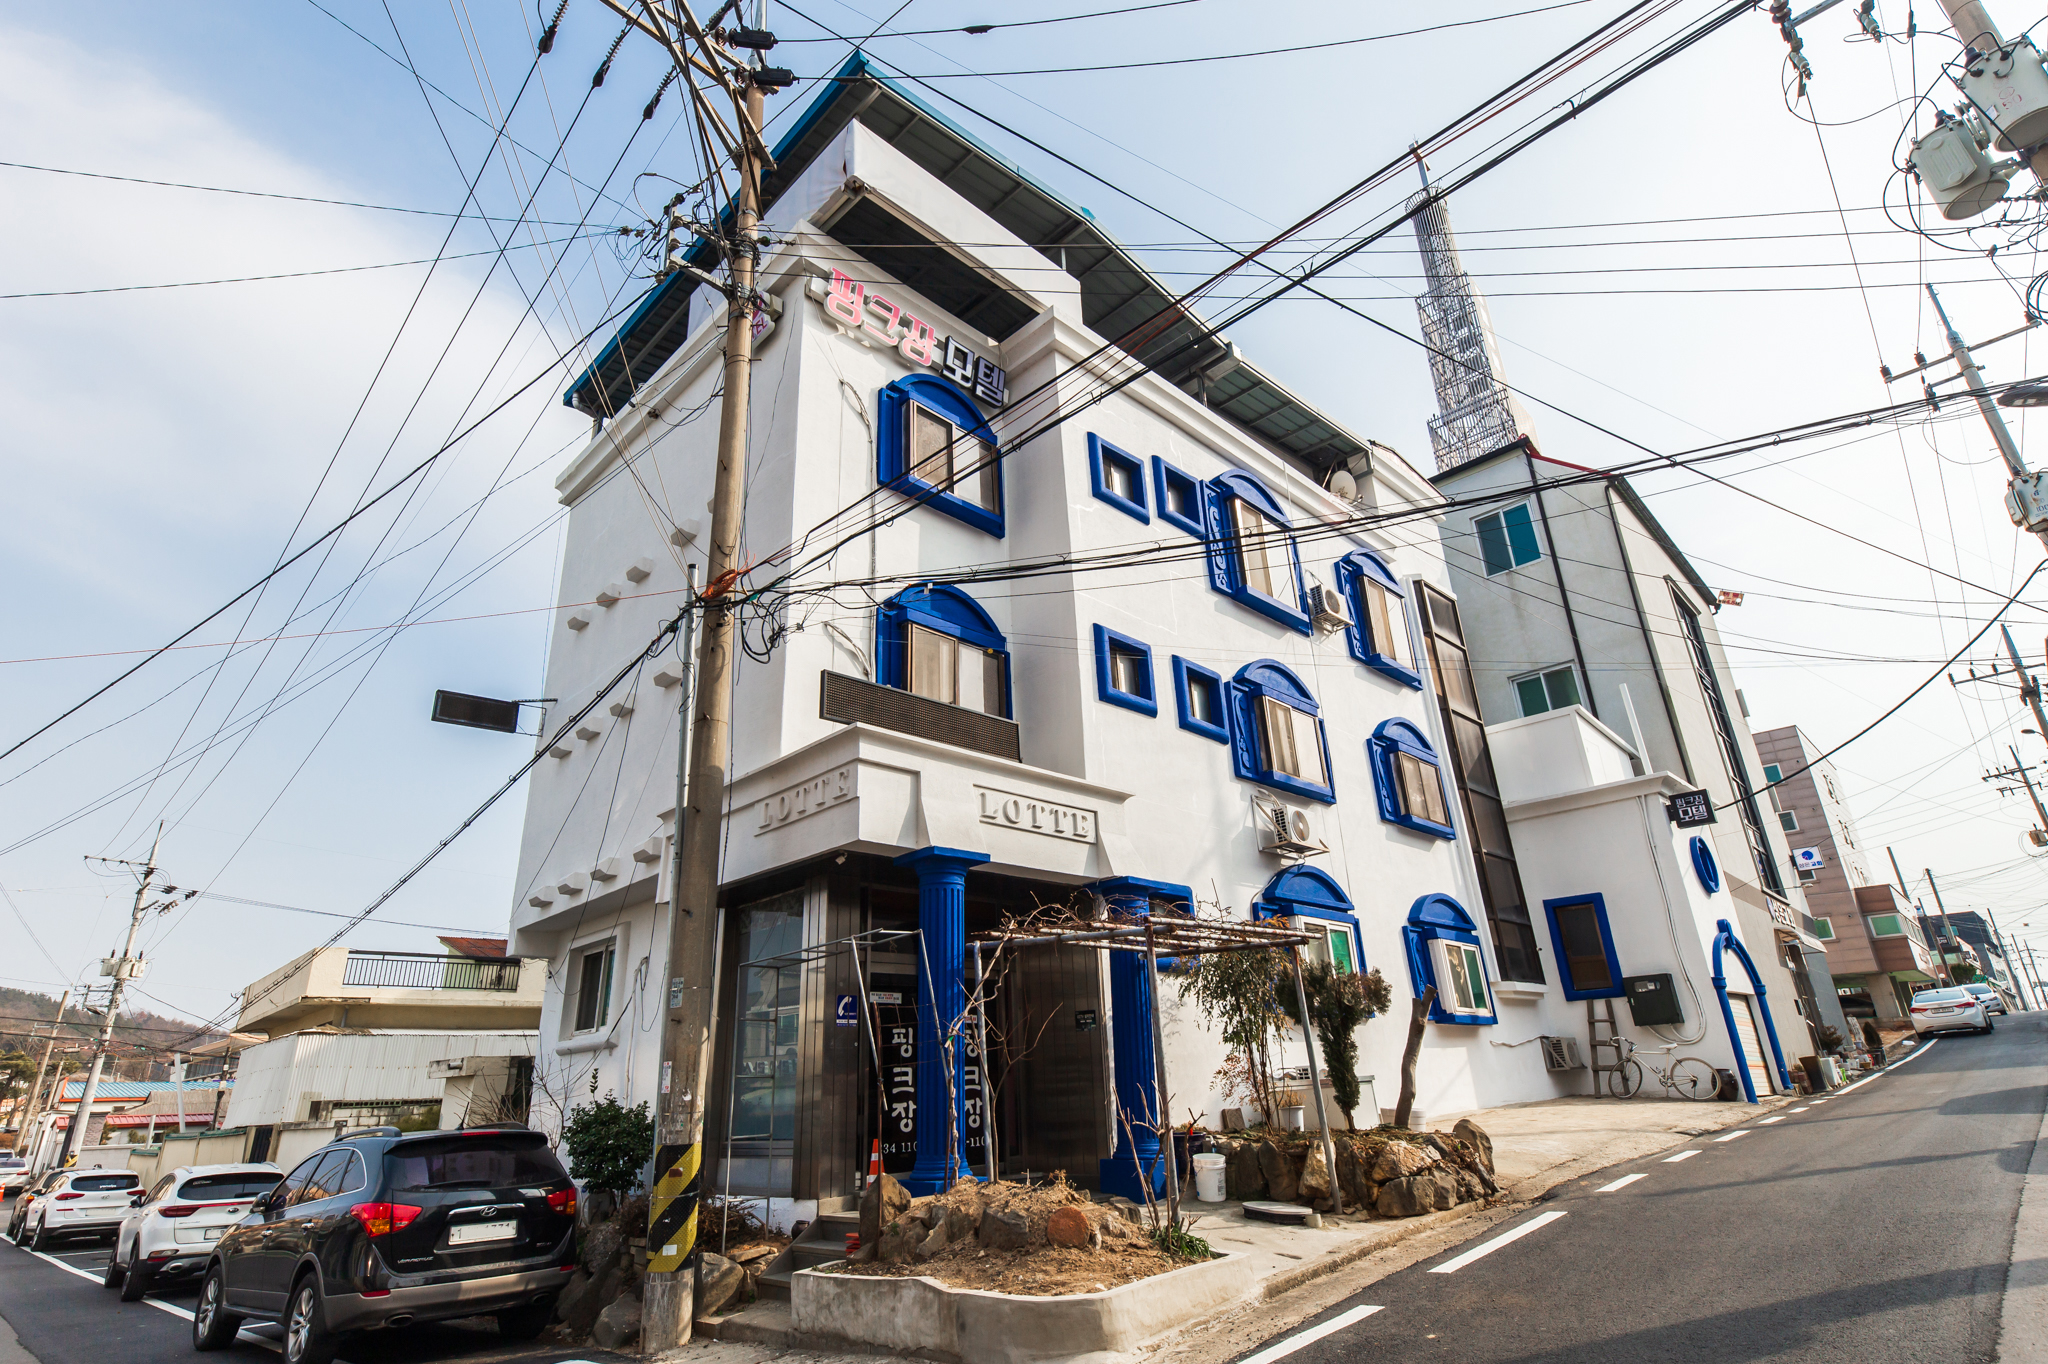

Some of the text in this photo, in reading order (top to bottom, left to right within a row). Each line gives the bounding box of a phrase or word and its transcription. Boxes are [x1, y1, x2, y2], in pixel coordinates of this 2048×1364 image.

[824, 267, 1006, 408] 핑크장 모텔
[757, 768, 850, 829] LOTTE
[978, 791, 1091, 838] LOTTE
[1675, 795, 1704, 808] 핑크장
[1678, 804, 1709, 822] 모텔
[891, 1027, 917, 1132] 핑크장
